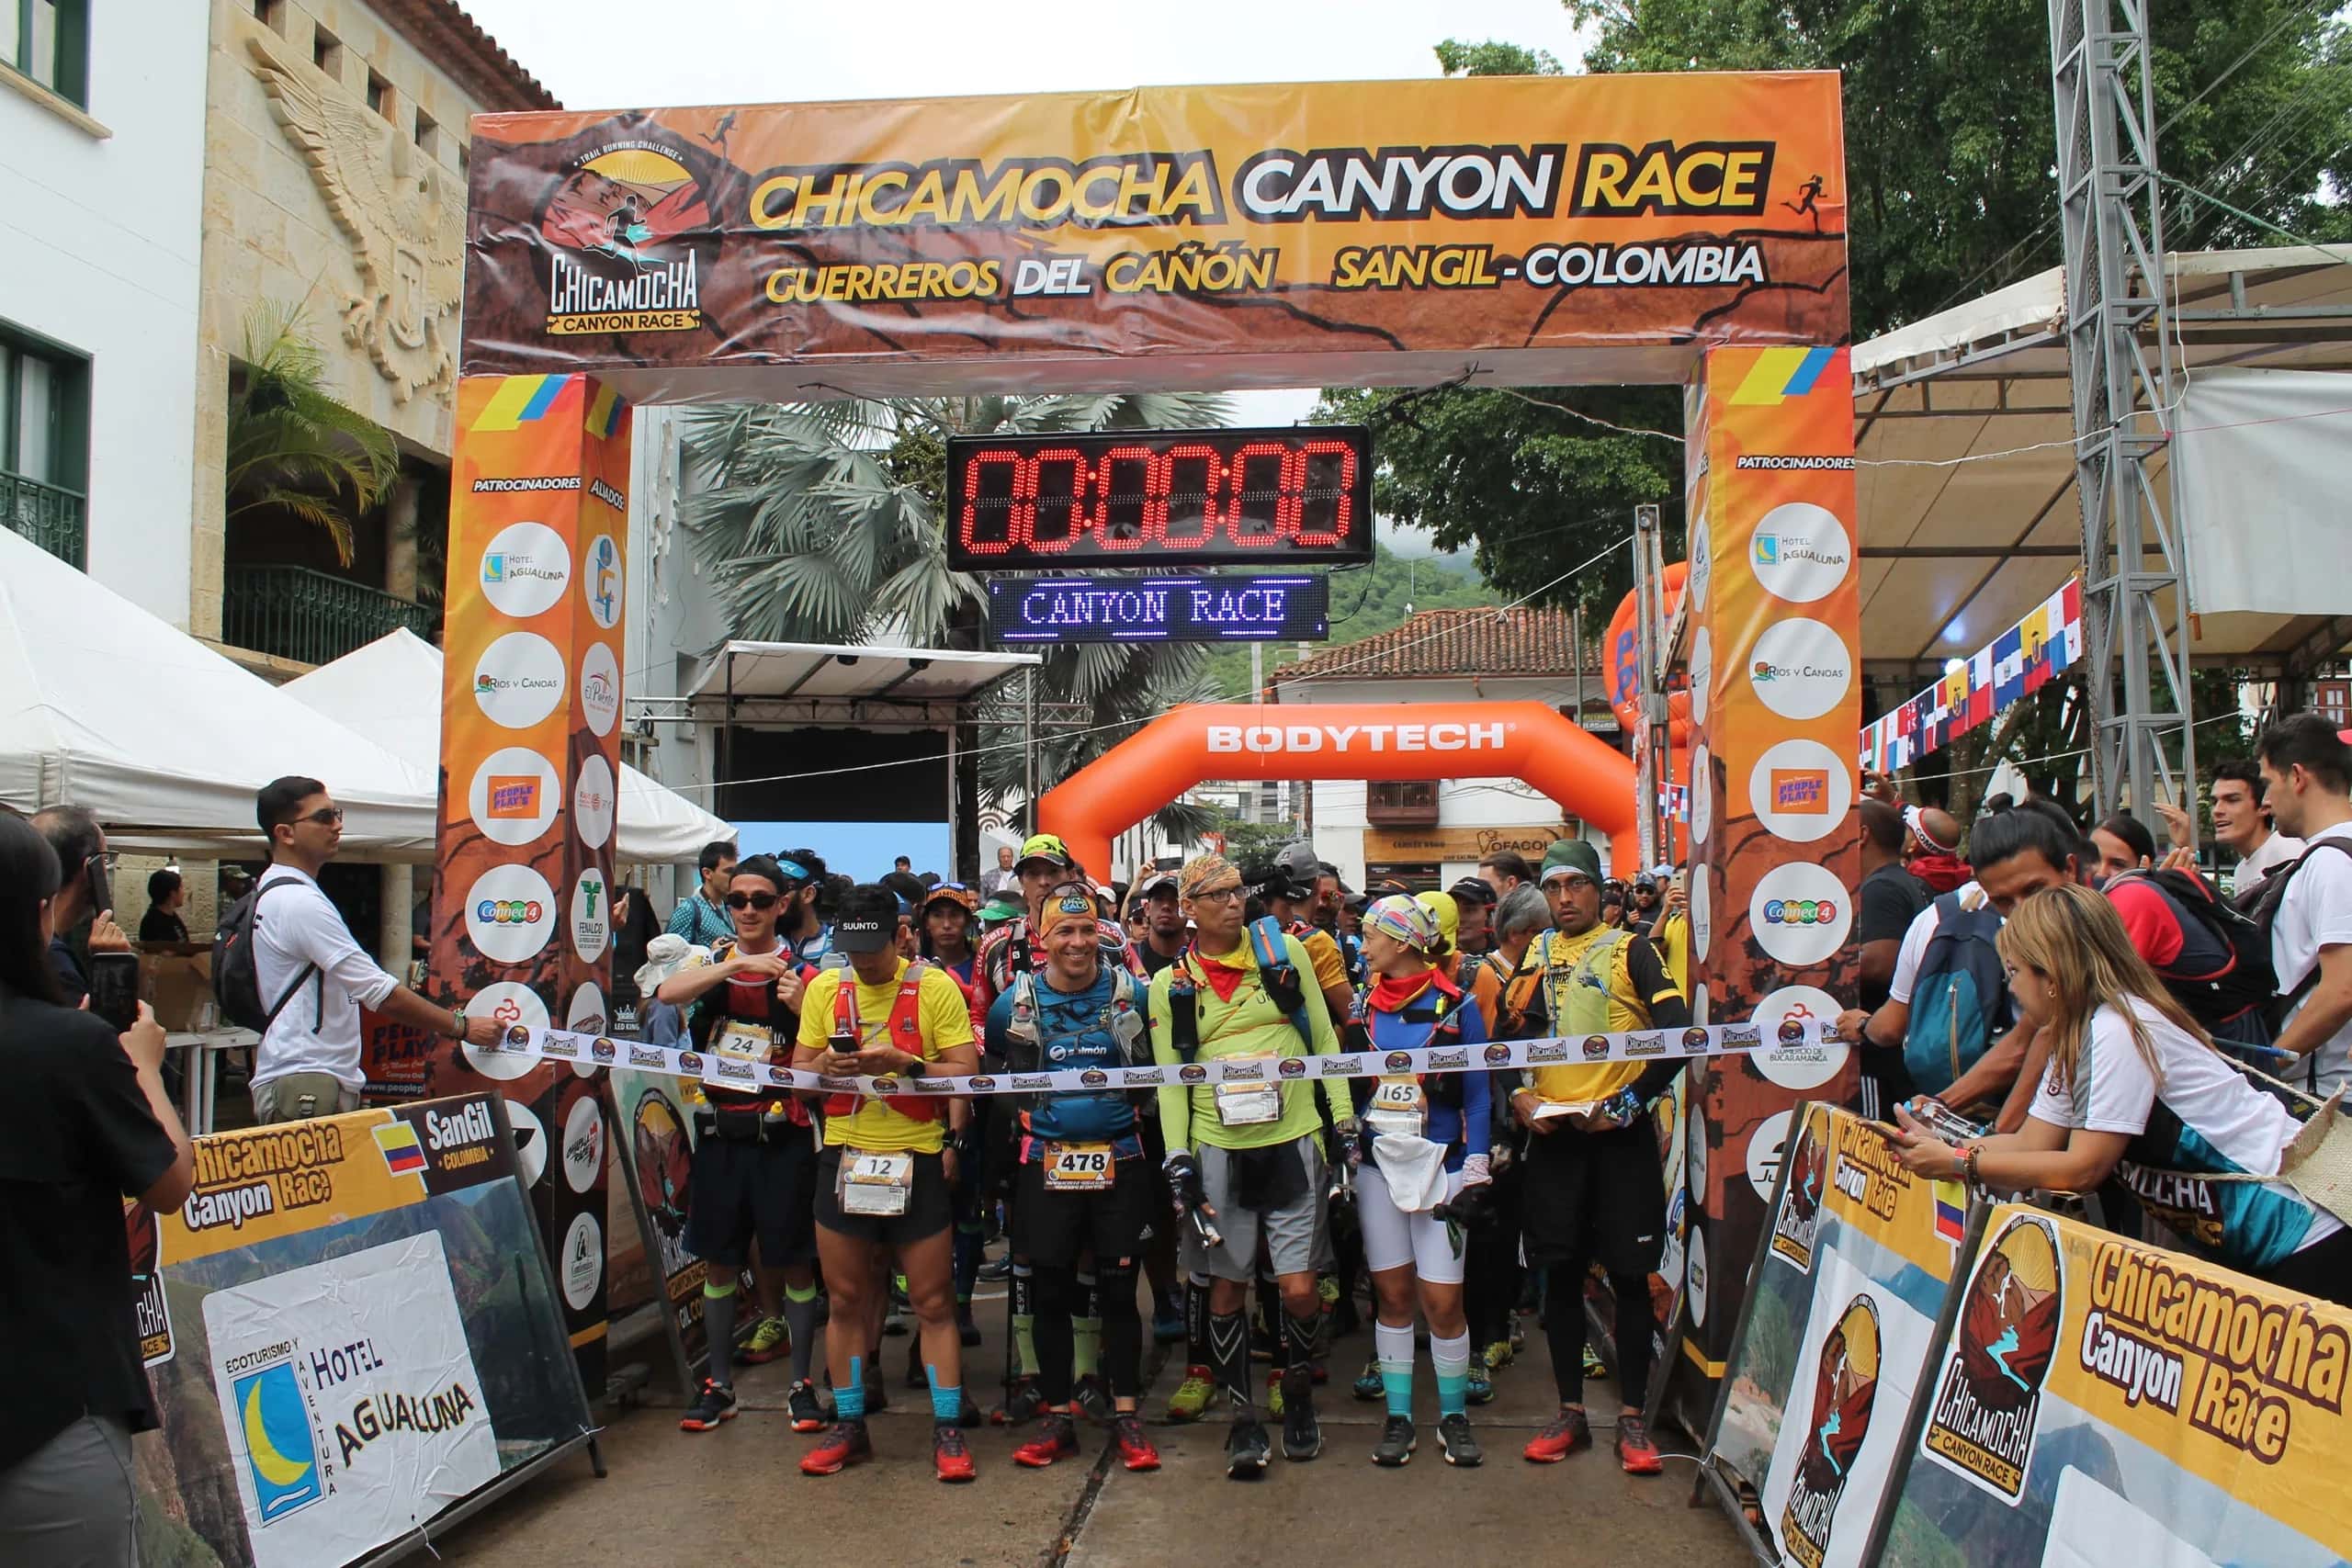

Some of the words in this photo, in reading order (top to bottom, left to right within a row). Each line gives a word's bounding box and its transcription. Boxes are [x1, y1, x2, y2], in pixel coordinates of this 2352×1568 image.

[581, 147, 601, 164] TRAIL
[604, 140, 636, 154] RUNNING
[638, 141, 679, 161] CHALLENGE
[749, 160, 1214, 229] CHICAMOCHA
[1242, 152, 1553, 213] CANYON
[1580, 151, 1762, 207] RACE
[551, 249, 697, 314] CHICAMOCHA
[765, 259, 1000, 303] GUERREROS
[1012, 258, 1091, 295] DEL
[1105, 244, 1272, 293] CAÑÓN
[563, 317, 634, 332] CANYON
[639, 313, 684, 329] RACE
[961, 441, 1356, 555] 00:00:00
[1781, 536, 1811, 546] HOTEL
[509, 555, 534, 563] HOTEL
[510, 566, 564, 581] AGUALUNA
[1783, 552, 1845, 565] AGUALUNA
[1023, 590, 1168, 624] CANYON
[1191, 589, 1284, 622] RACE
[1206, 723, 1504, 753] BODYTECH
[482, 904, 526, 919] Connect
[528, 905, 537, 919] 4
[1769, 900, 1819, 919] Connect
[1821, 900, 1831, 919] 4
[579, 921, 603, 934] FENALCO
[842, 921, 878, 931] SUUNTO
[615, 1022, 625, 1031] LED
[730, 1036, 753, 1053] 24
[1383, 1086, 1413, 1101] 165
[426, 1102, 494, 1151] SanGil
[185, 1124, 343, 1185] hicamocha
[444, 1145, 489, 1171] COLOMBIA
[870, 1159, 891, 1175] 12
[1061, 1154, 1105, 1171] 478
[185, 1182, 273, 1229] Canyon
[279, 1168, 332, 1213] Race
[2091, 1243, 2349, 1413] Chicamocha
[226, 1344, 292, 1374] ECOTURISMO
[291, 1337, 300, 1351] Y
[313, 1337, 384, 1392] HOTEL
[2081, 1311, 2184, 1409] Canyon
[2195, 1362, 2289, 1459] Race
[297, 1359, 338, 1497] AVENTURA
[333, 1382, 476, 1470] AGUALUNA
[1936, 1357, 2037, 1468] CHICAMOCHA
[1942, 1436, 1984, 1468] CANYON
[1981, 1457, 2010, 1484] RACE
